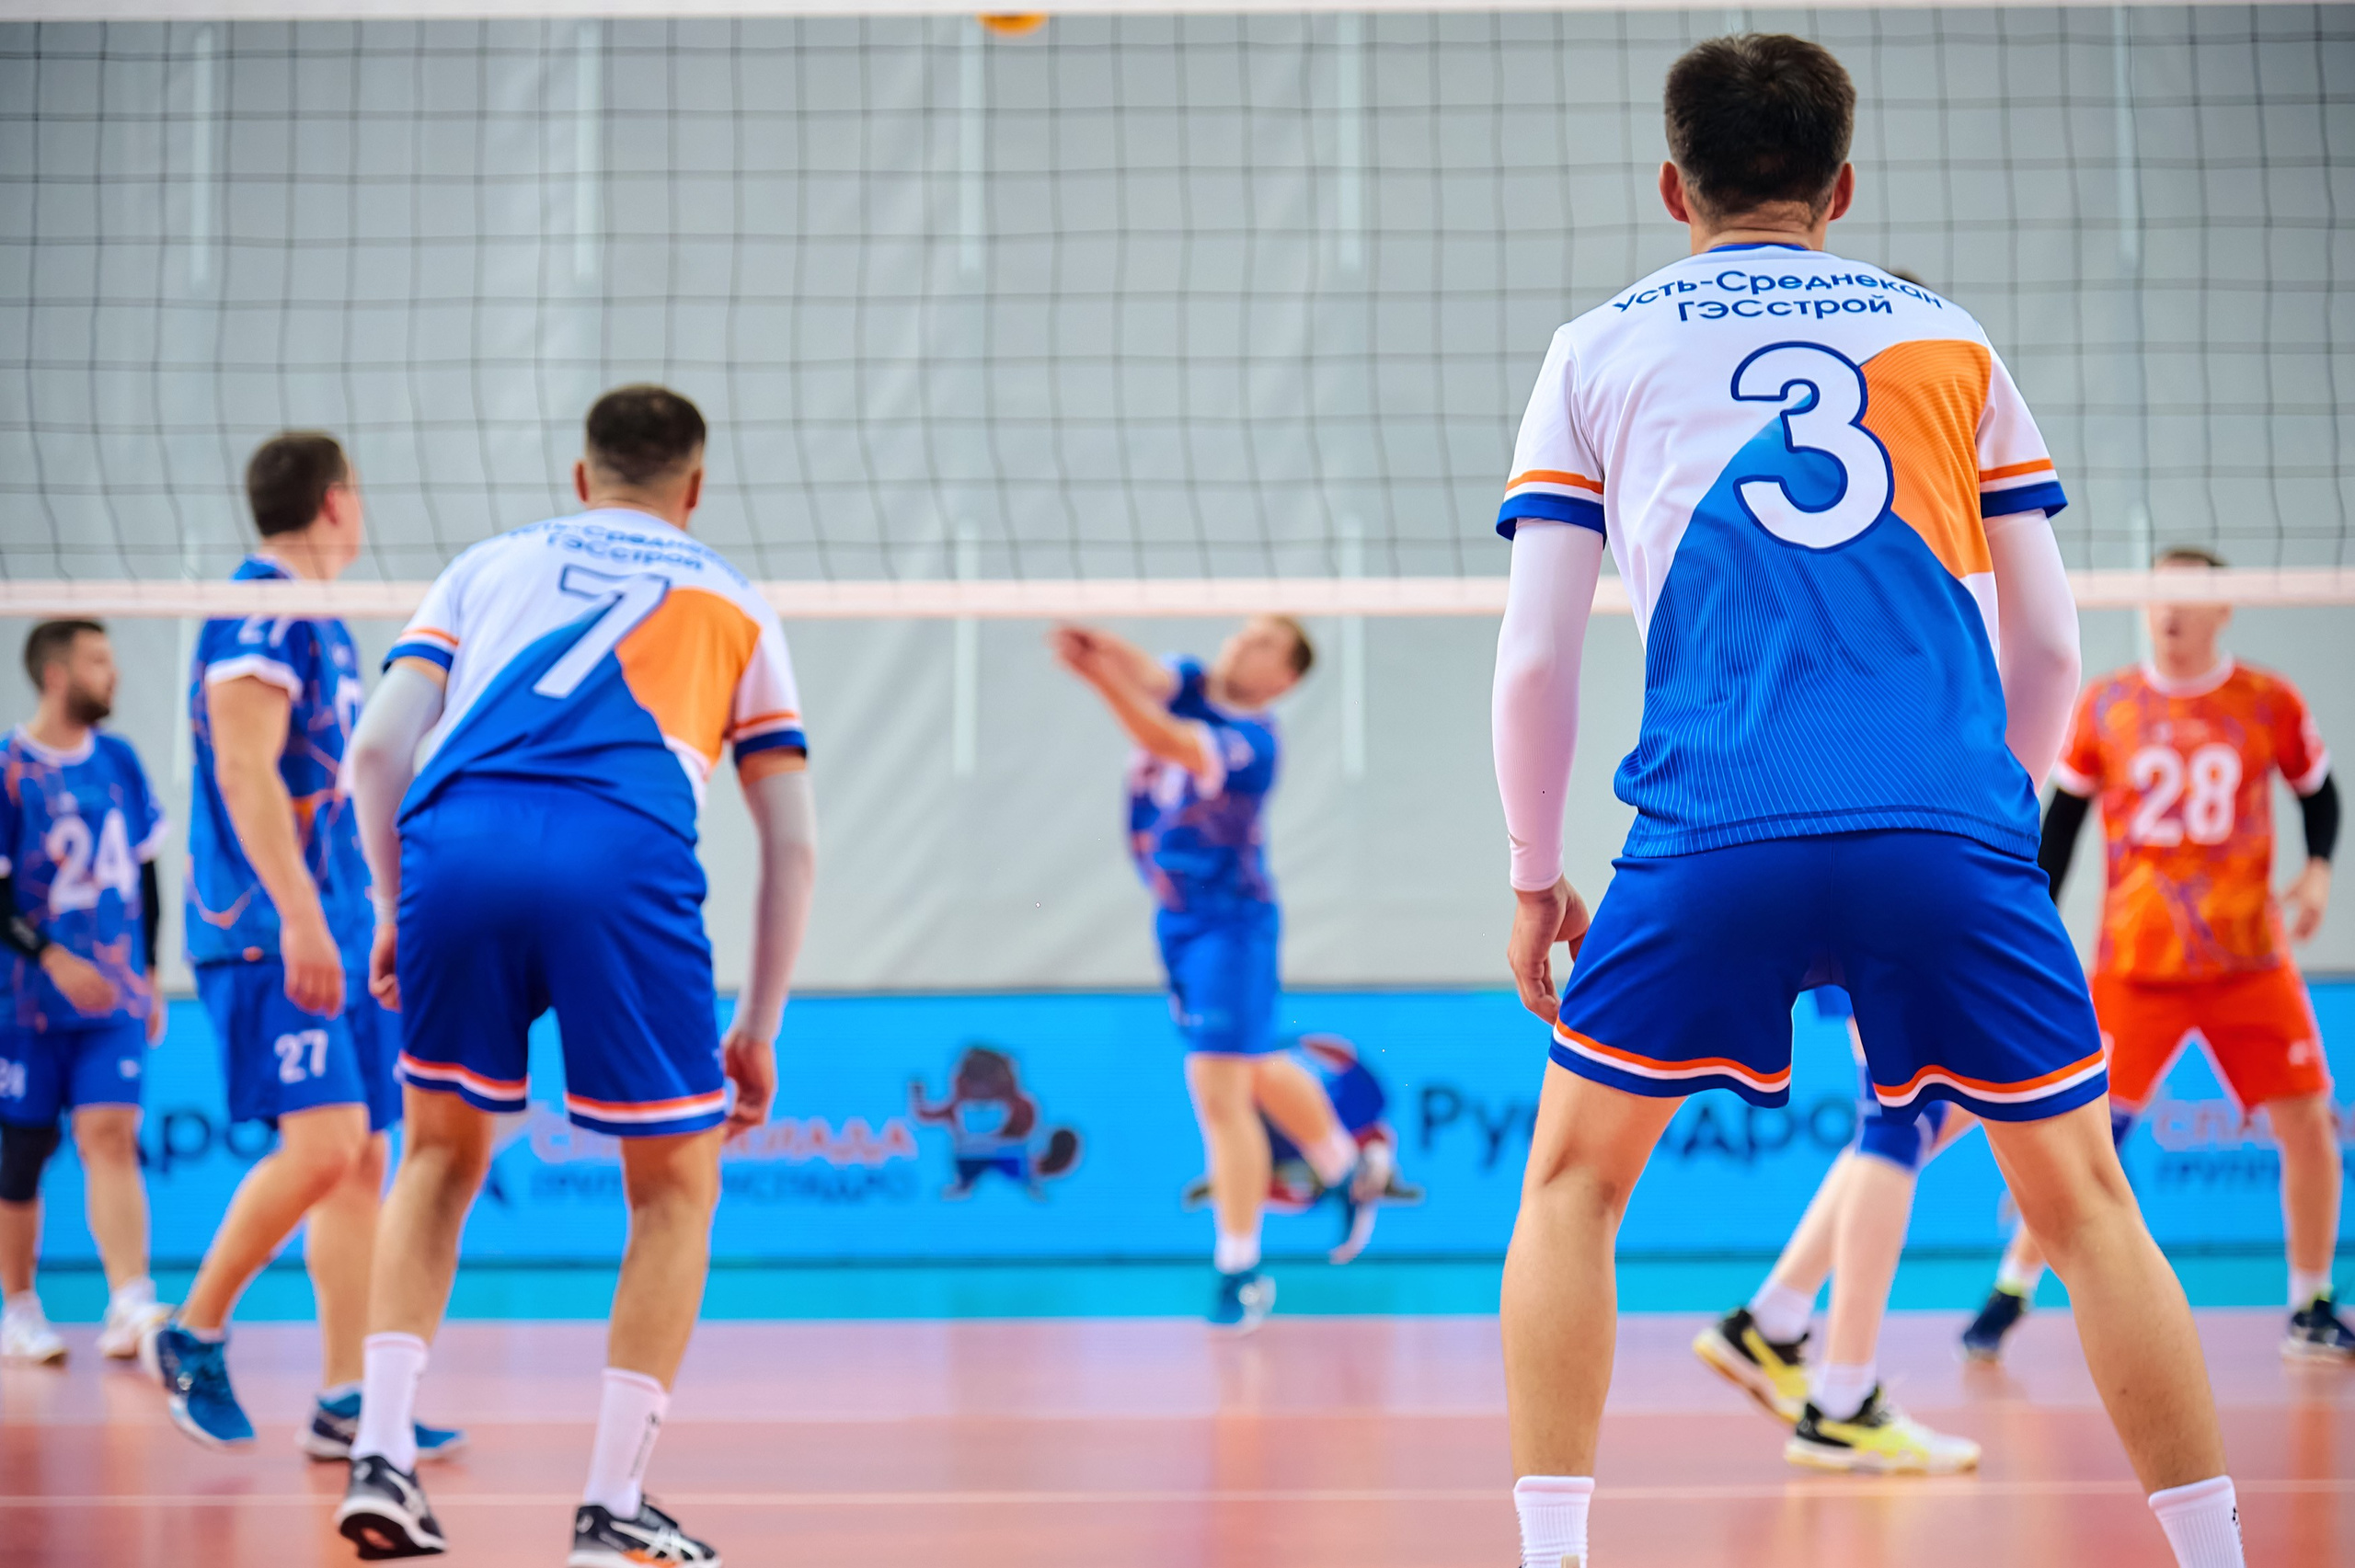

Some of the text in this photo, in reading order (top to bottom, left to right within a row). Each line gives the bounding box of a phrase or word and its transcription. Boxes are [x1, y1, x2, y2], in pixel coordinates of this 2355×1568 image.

[1612, 269, 1944, 313] Усть-Среднекан
[1677, 293, 1893, 322] ГЭСстрой
[1730, 340, 1896, 554] 3
[531, 563, 673, 700] 7
[2129, 741, 2243, 847] 28
[47, 807, 139, 914] 24
[275, 1028, 329, 1083] 27
